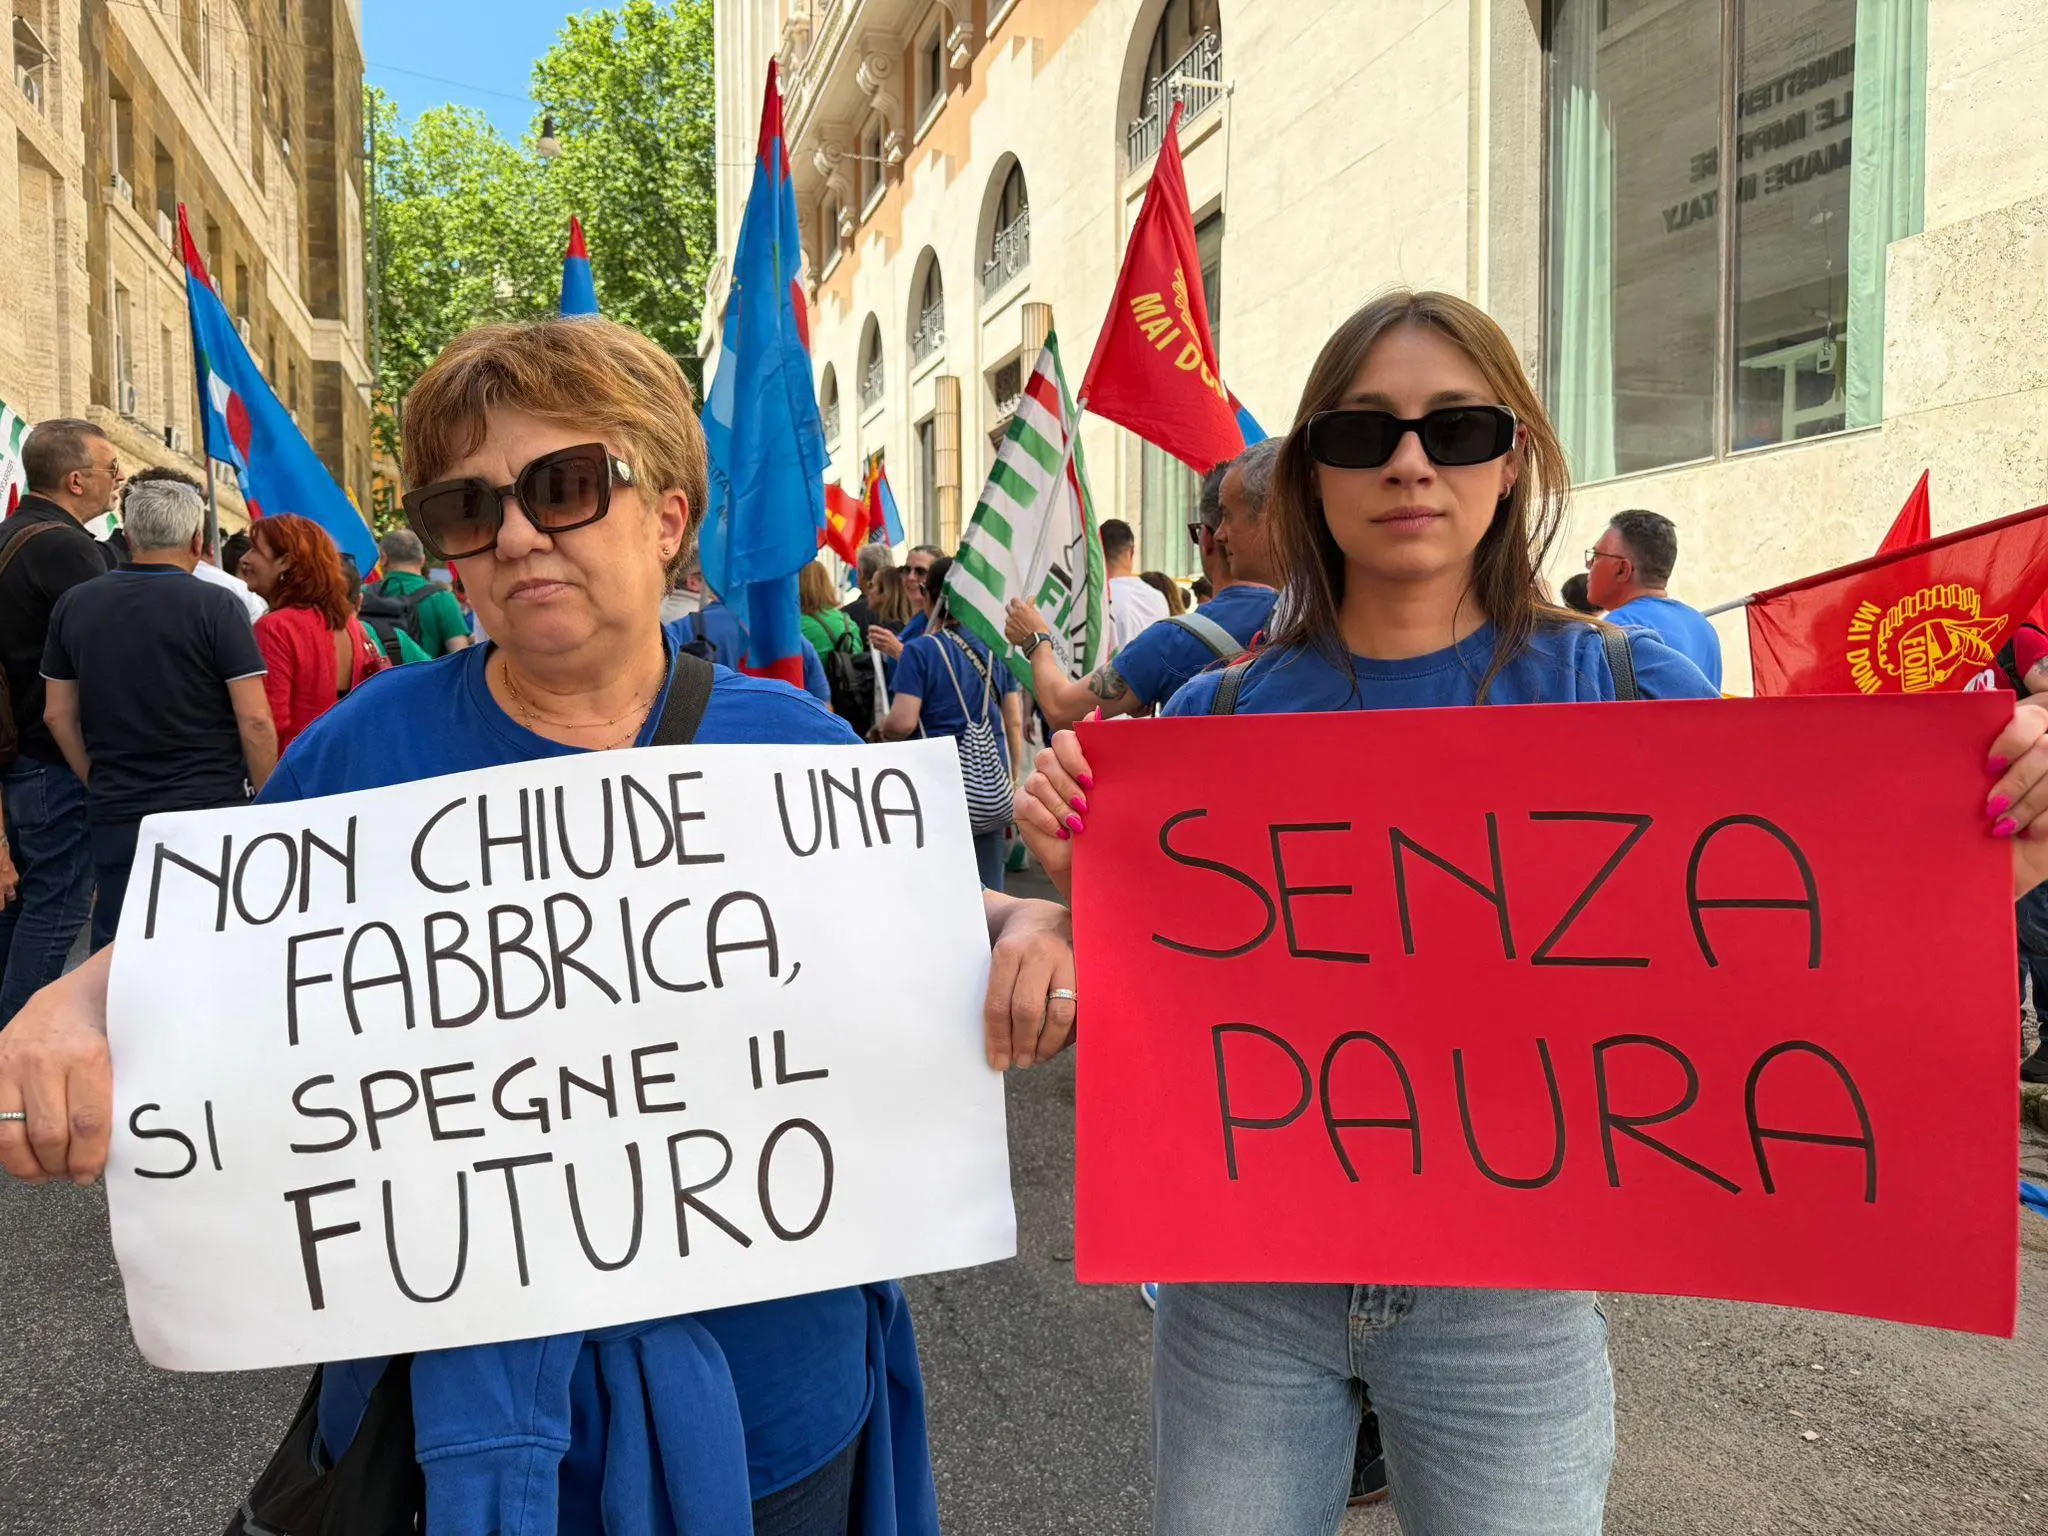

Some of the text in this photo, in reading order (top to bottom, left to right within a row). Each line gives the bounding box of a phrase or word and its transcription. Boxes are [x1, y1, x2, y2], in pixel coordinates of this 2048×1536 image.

[1130, 292, 1223, 398] MAI DO
[1847, 600, 1882, 641] MAI
[1903, 636, 1929, 687] FIOM
[145, 768, 923, 939] NON CHIUDE UNA
[1152, 809, 1821, 969] SENZA
[286, 891, 801, 1045] FABBRICA,
[129, 1030, 828, 1178] SI SPEGNE IL
[1212, 1023, 1876, 1203] PAURA
[284, 1118, 834, 1310] FUTURO
